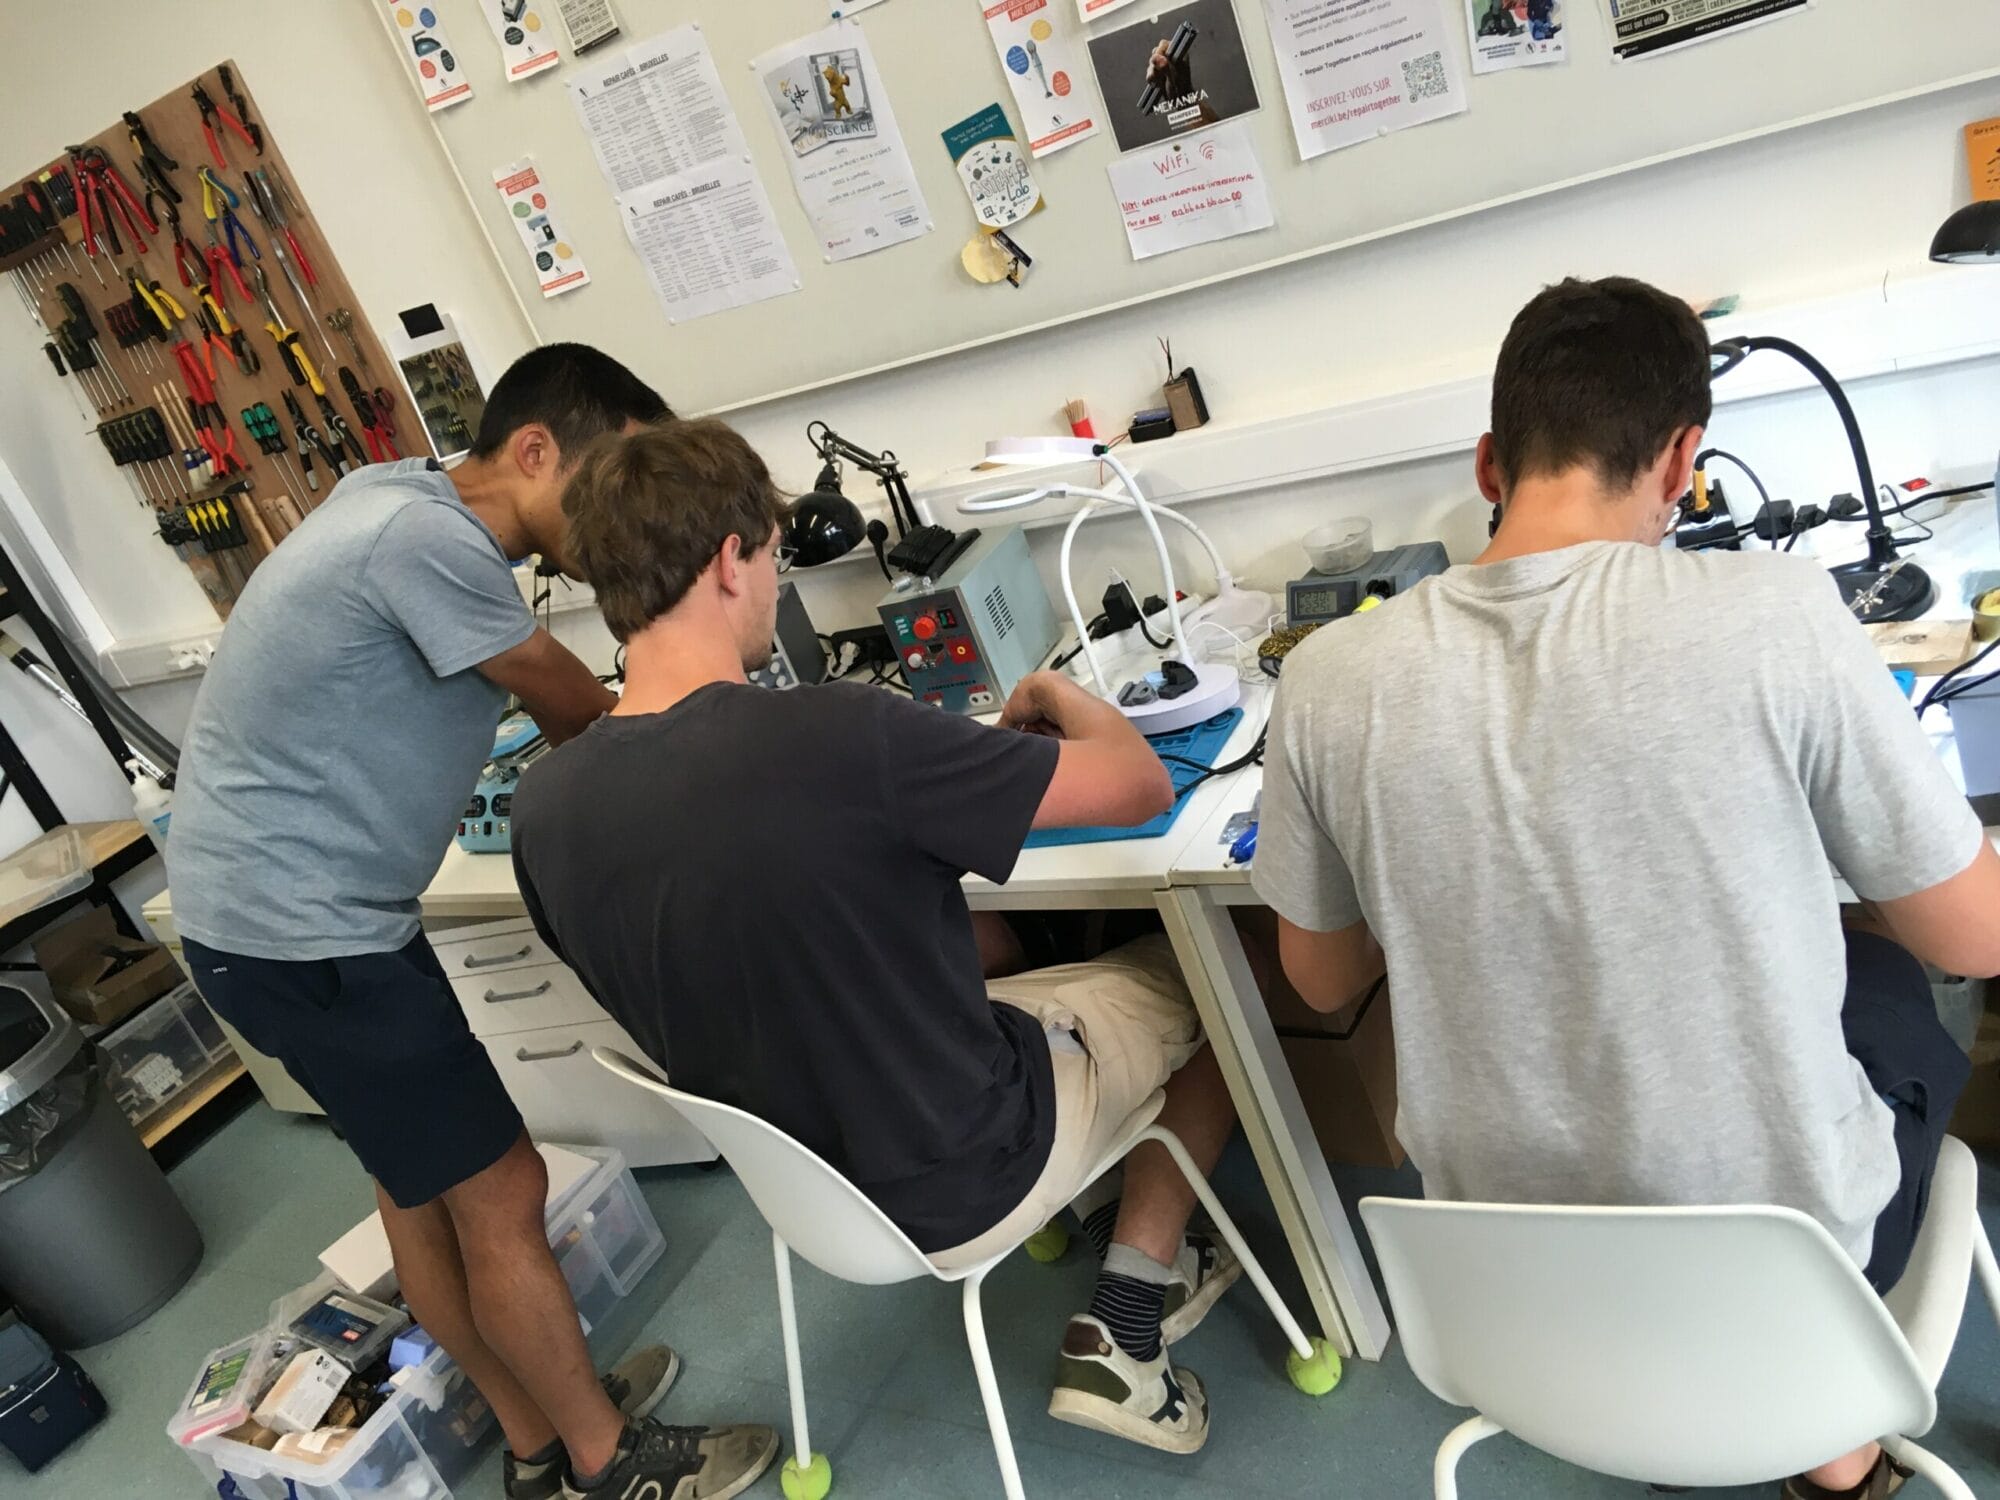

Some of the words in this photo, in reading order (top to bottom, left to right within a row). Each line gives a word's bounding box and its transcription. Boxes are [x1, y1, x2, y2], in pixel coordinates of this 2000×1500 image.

[1292, 17, 1318, 29] monnaie
[1319, 7, 1344, 20] solidaire
[1299, 44, 1325, 57] Recevez
[1334, 33, 1354, 45] Mercis
[1304, 64, 1324, 76] Repair
[1324, 55, 1352, 69] Together
[1380, 33, 1415, 51] également
[603, 74, 621, 87] REPAIR
[639, 53, 669, 71] BRUXELLES
[1306, 82, 1373, 113] INSCRIVEZ-VOUS
[1373, 77, 1391, 92] SUR
[653, 196, 671, 208] REPAIR
[691, 179, 721, 196] BRUXELLES
